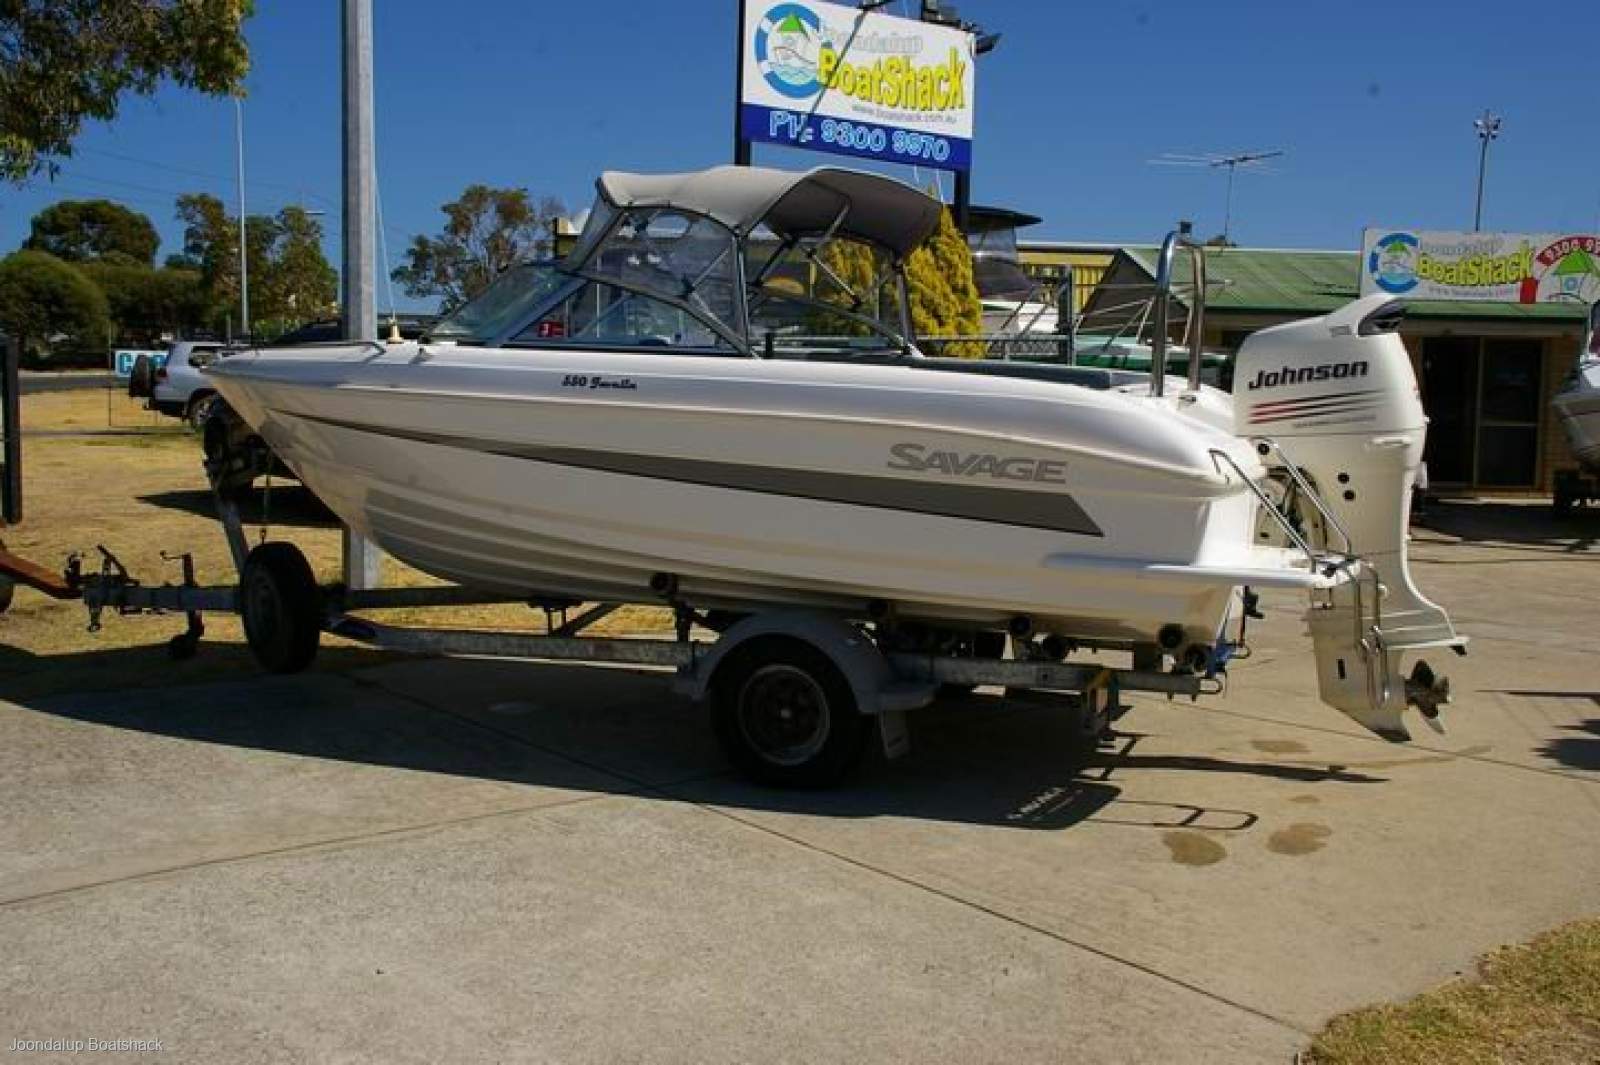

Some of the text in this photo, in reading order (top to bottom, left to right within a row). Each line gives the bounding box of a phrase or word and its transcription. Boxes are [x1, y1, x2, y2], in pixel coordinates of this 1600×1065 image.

[817, 47, 966, 110] BoatShack
[1415, 240, 1534, 286] BoatShack
[1248, 361, 1368, 391] Johnson
[887, 442, 1069, 484] SAVAGE
